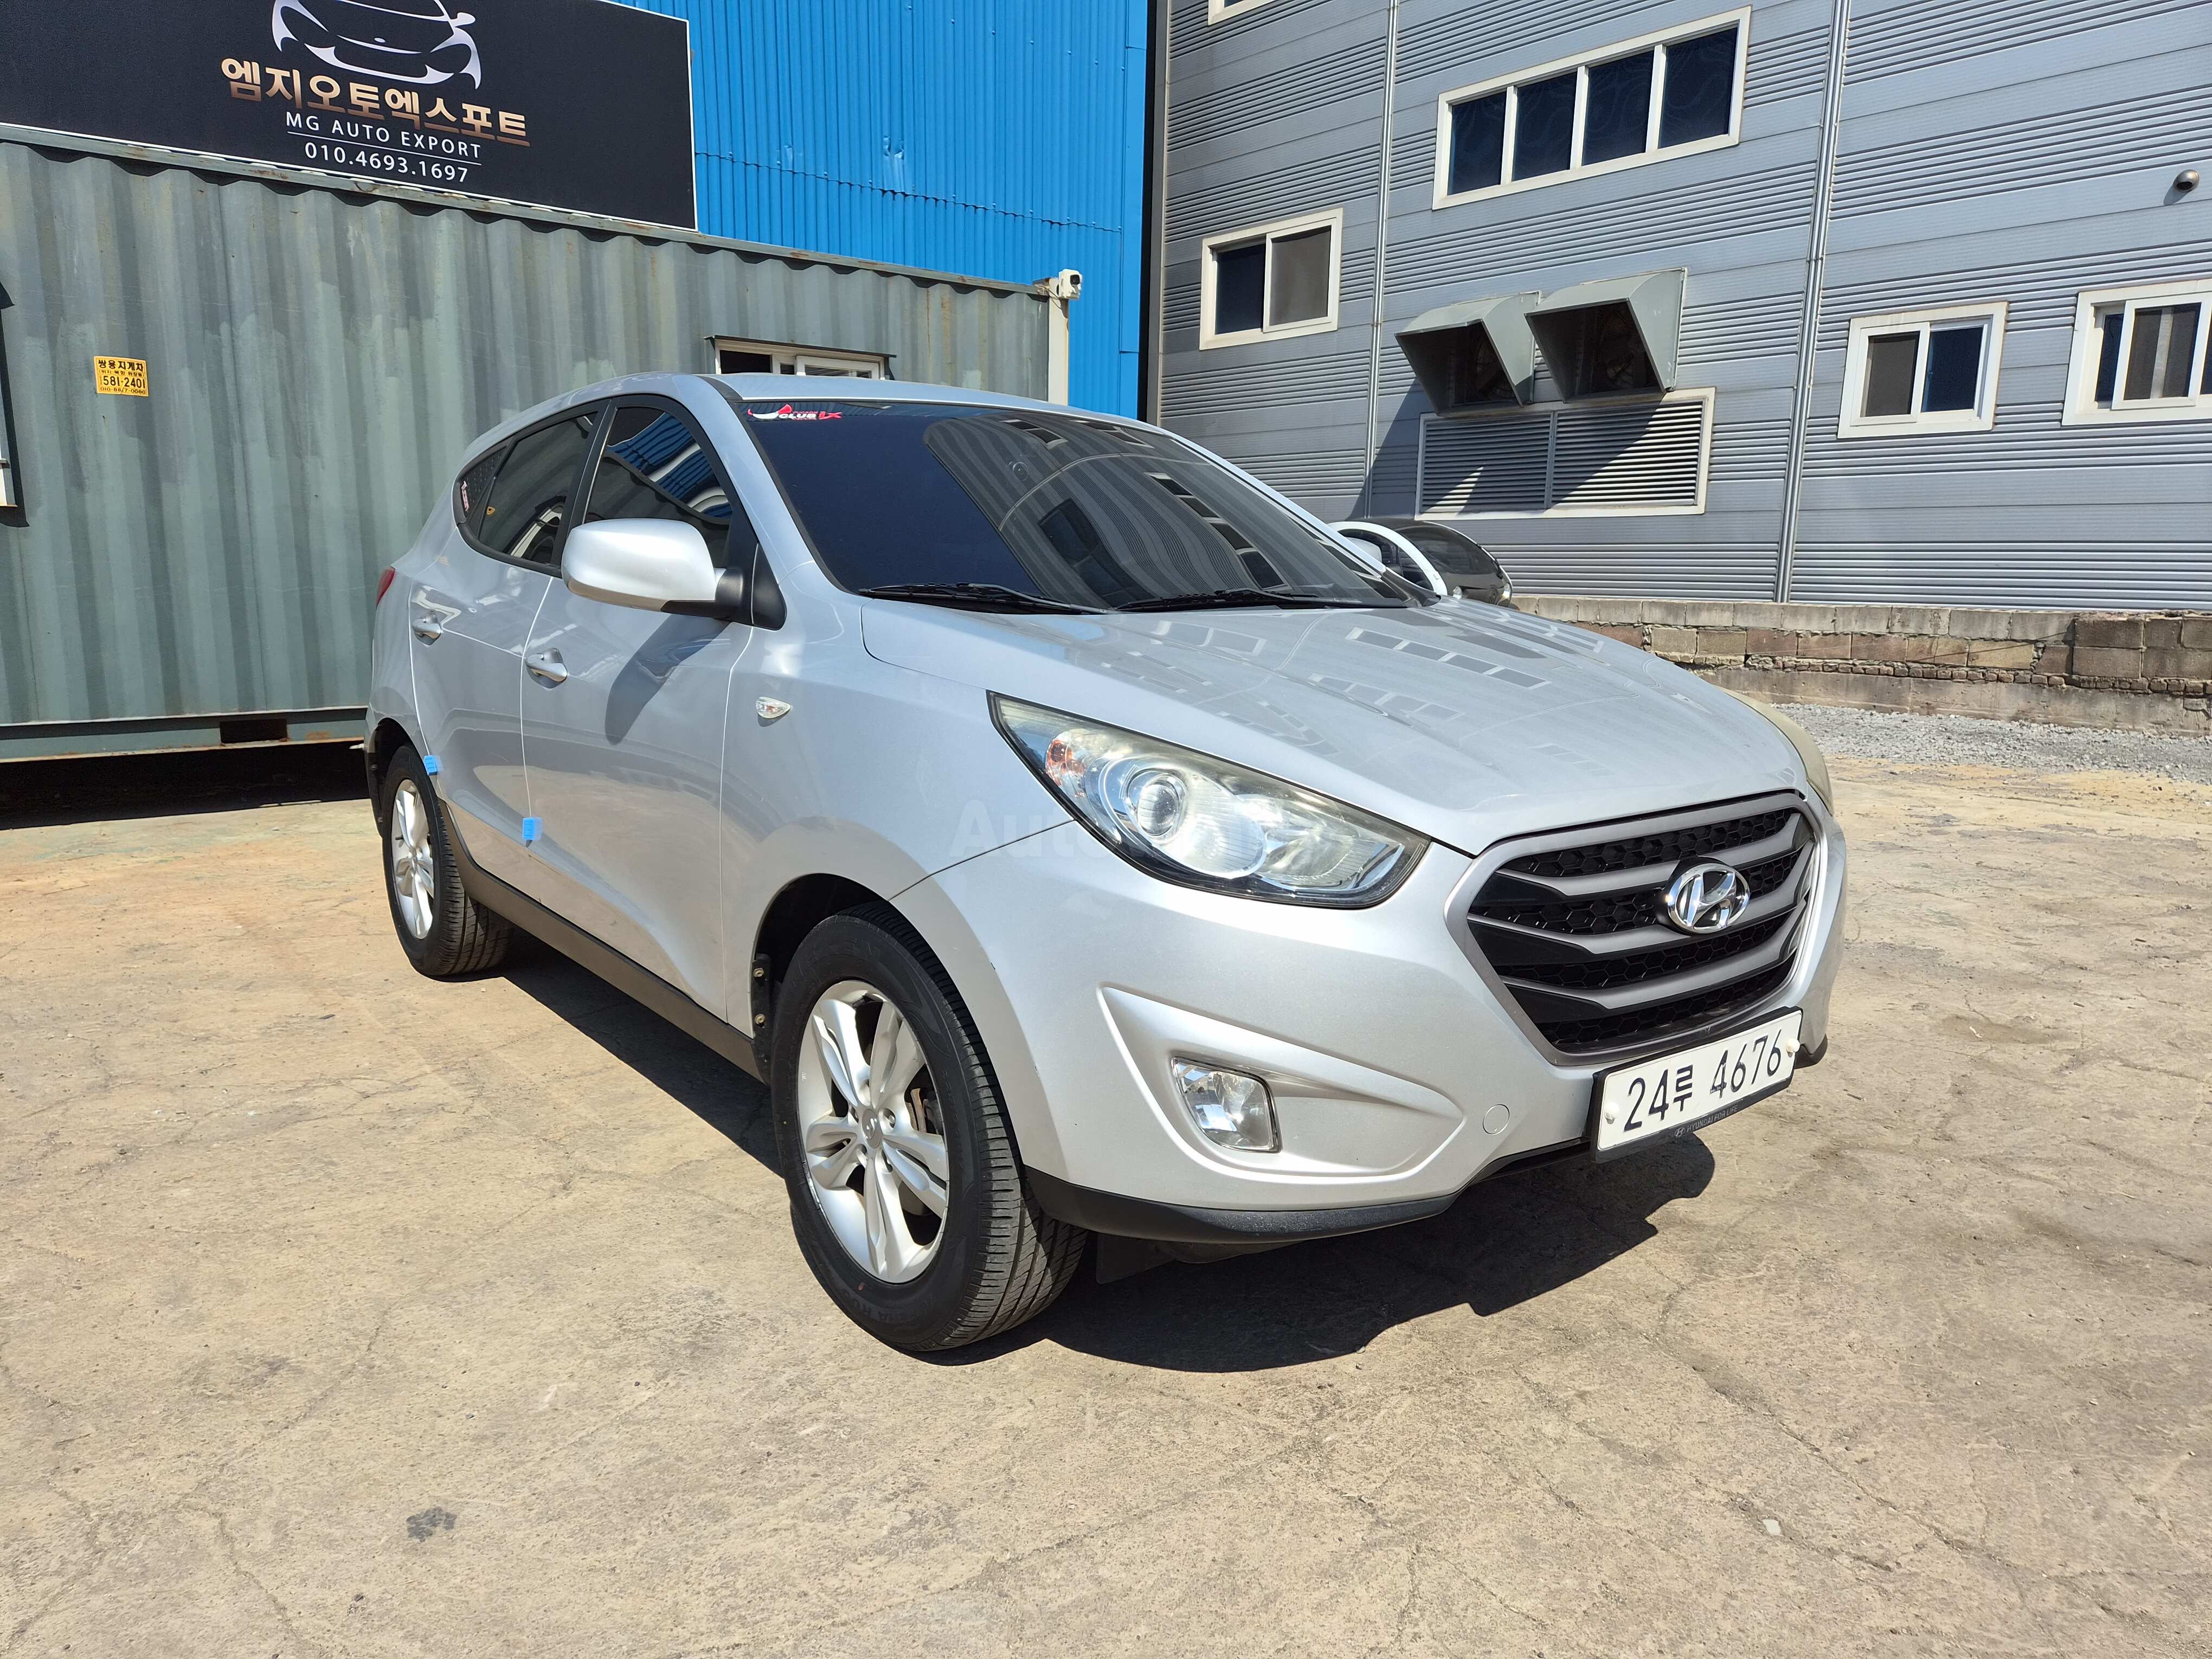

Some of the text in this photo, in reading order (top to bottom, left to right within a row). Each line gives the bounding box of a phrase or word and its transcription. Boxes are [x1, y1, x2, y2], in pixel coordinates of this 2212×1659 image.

[221, 57, 530, 147] 엠지오토엑스포트
[286, 111, 482, 159] MG AUTO EXPORT
[304, 142, 468, 183] 010.4693.1697
[98, 359, 144, 372] 쌍용지게차
[1623, 1028, 1783, 1133] 24루 4676
[1687, 1105, 1738, 1132] HYUNDAI FOR LIFE
